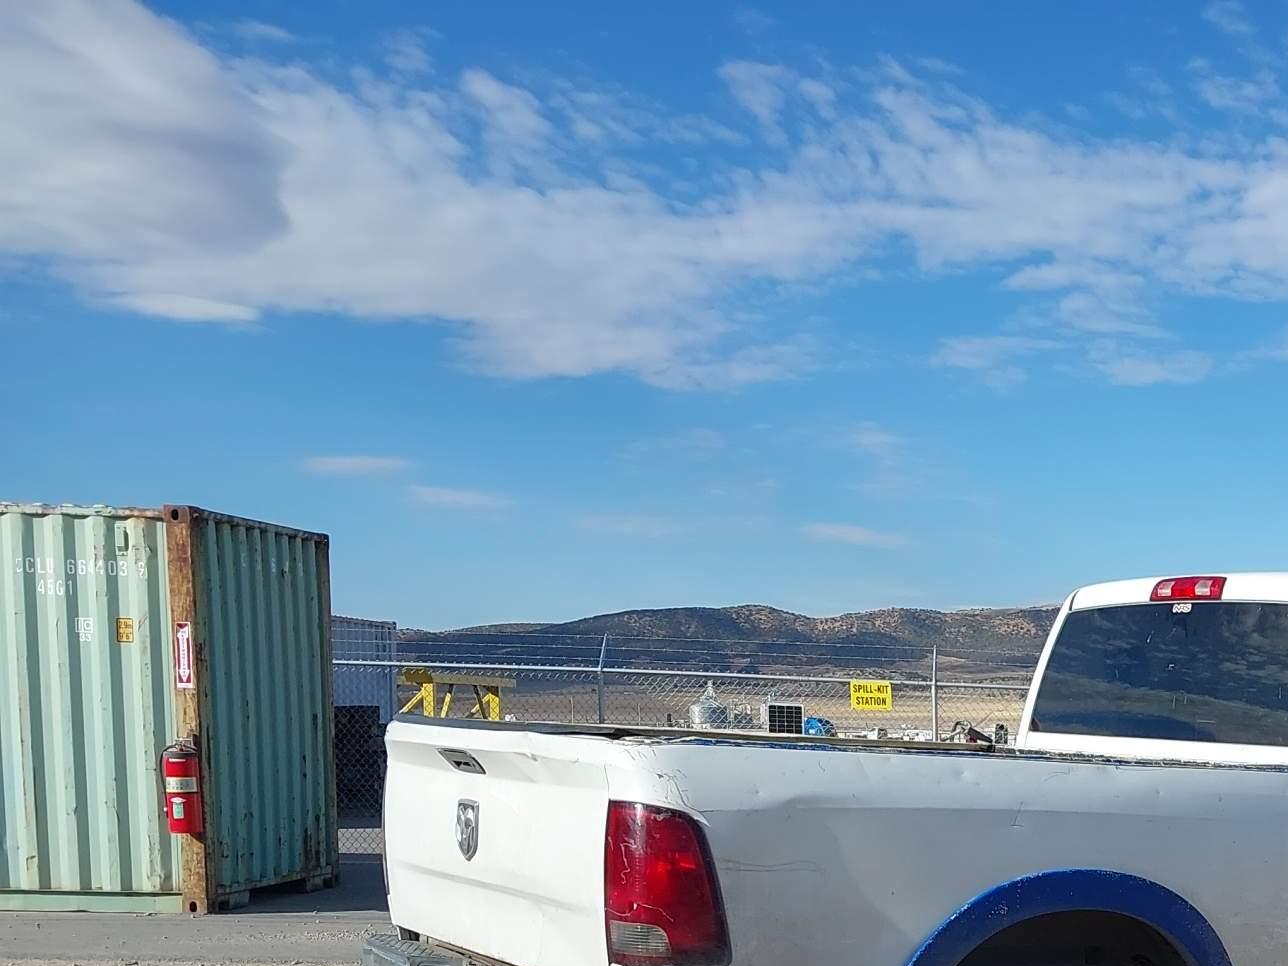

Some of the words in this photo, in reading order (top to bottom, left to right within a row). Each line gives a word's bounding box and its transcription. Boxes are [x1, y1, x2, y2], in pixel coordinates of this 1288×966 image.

[67, 559, 128, 576] 664403
[37, 579, 73, 596] 45G1
[852, 684, 889, 694] SPILL-KIT
[856, 696, 887, 706] STATION
